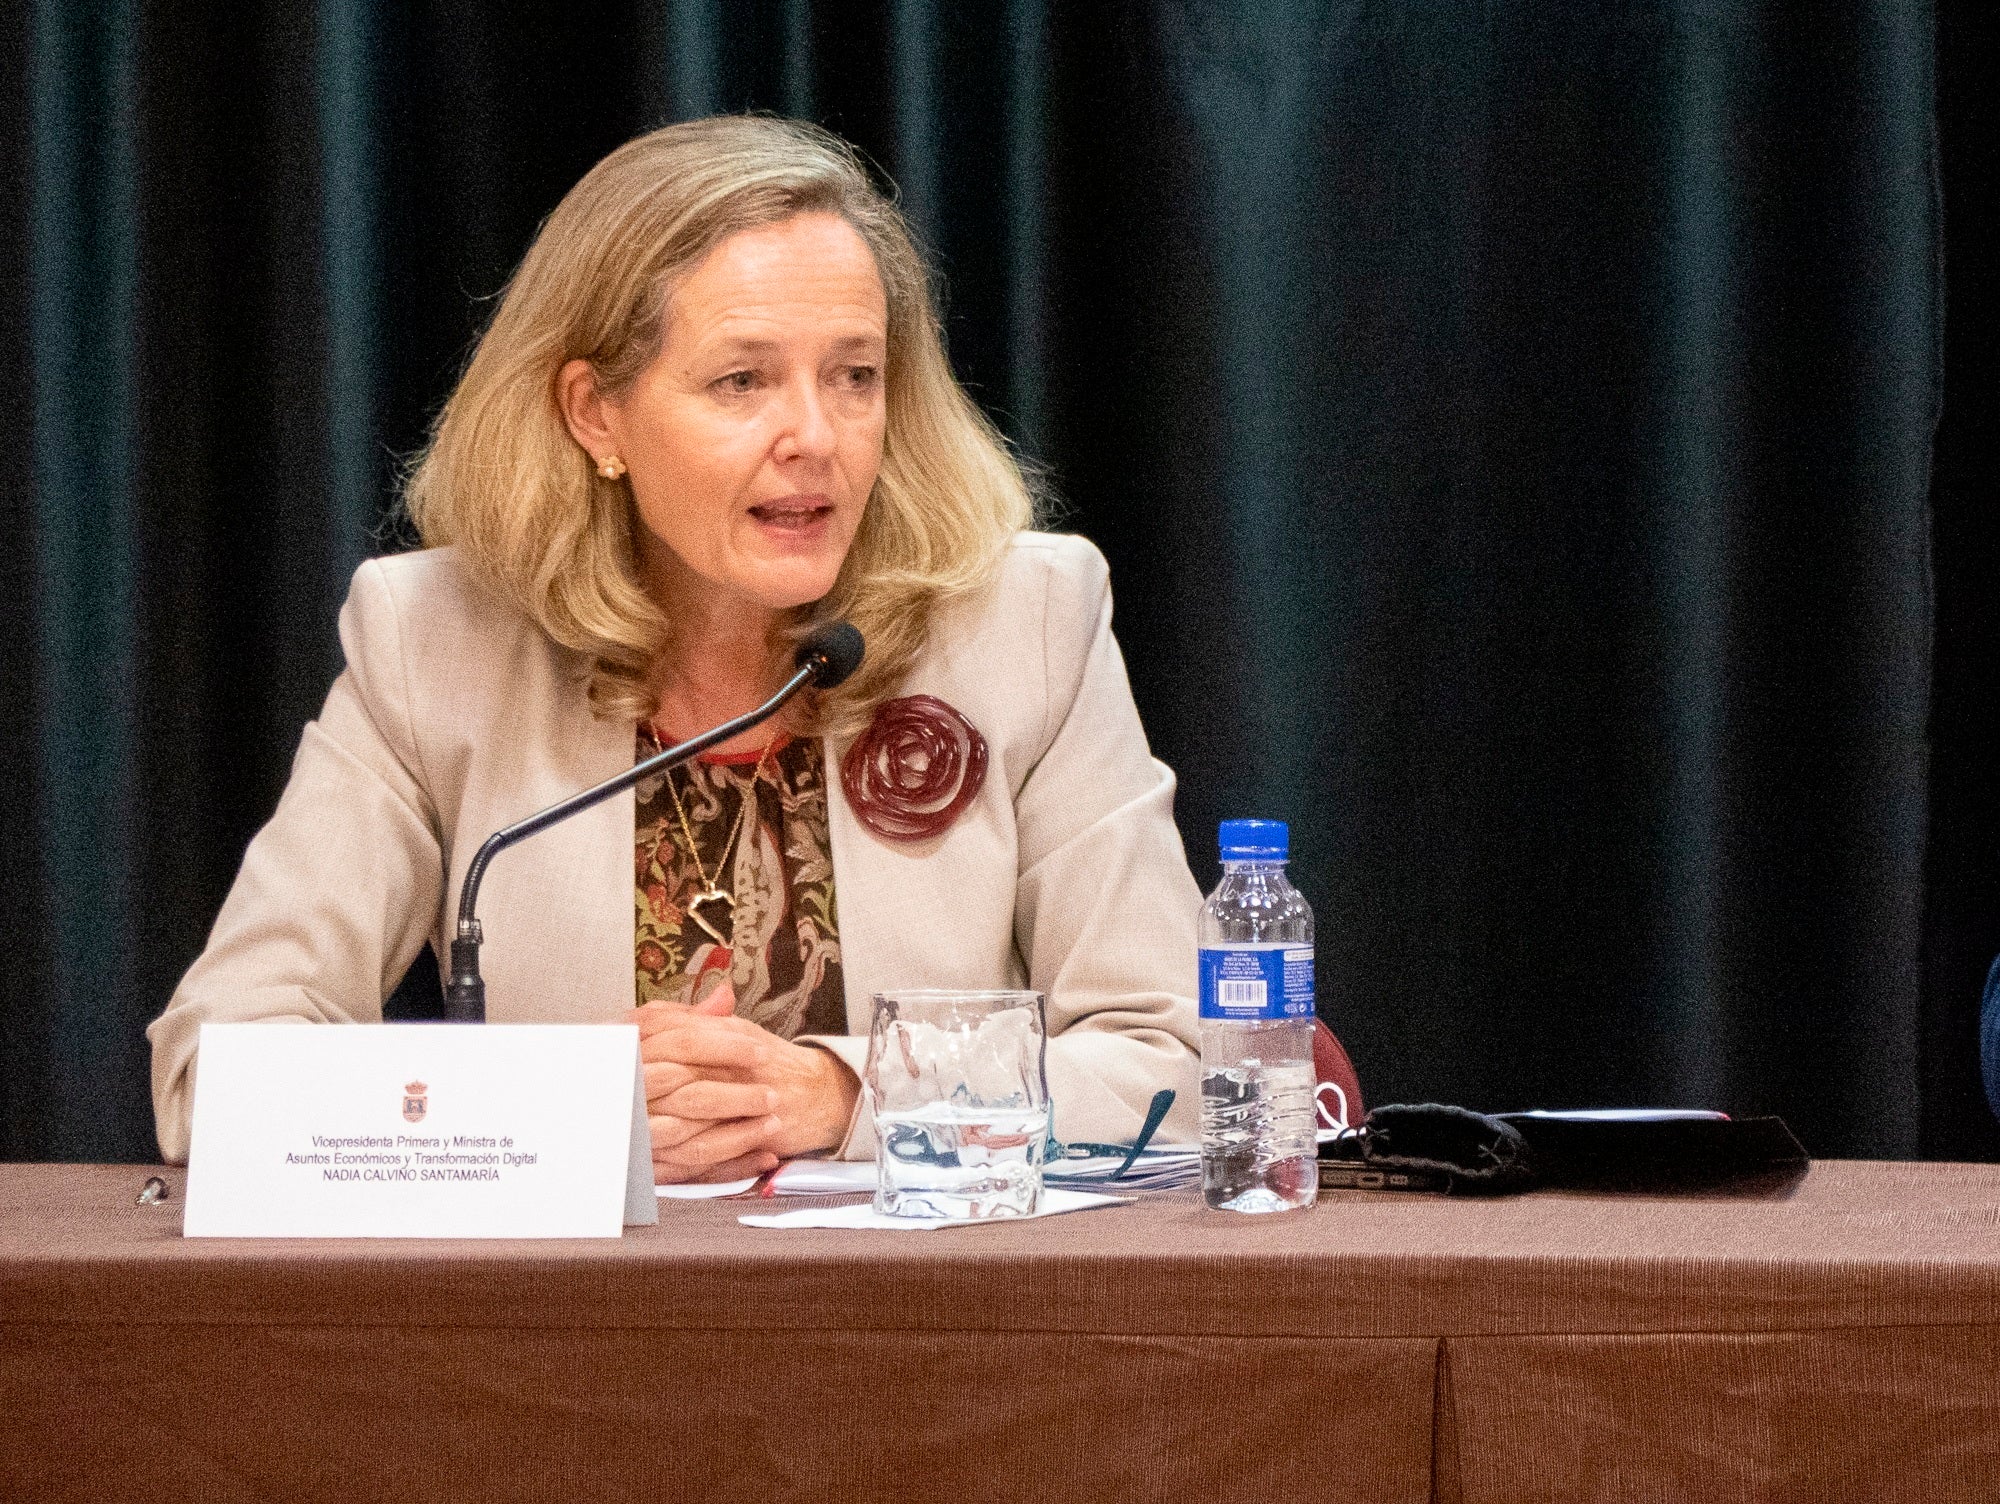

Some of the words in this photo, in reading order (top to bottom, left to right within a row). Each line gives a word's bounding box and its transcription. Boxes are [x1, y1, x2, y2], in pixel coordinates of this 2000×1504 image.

[312, 1136, 393, 1150] Vicepresidenta
[397, 1136, 440, 1147] Primera
[443, 1138, 450, 1150] y
[453, 1136, 496, 1147] Ministra
[499, 1136, 514, 1147] de
[286, 1153, 331, 1164] Asuntos
[334, 1153, 401, 1164] Económicos
[404, 1155, 411, 1167] y
[414, 1153, 500, 1164] Transformación
[503, 1153, 538, 1167] Digital
[323, 1169, 361, 1180] NADIA
[363, 1167, 417, 1180] CALVIÑO
[420, 1167, 500, 1180] SANTAMARÍA
